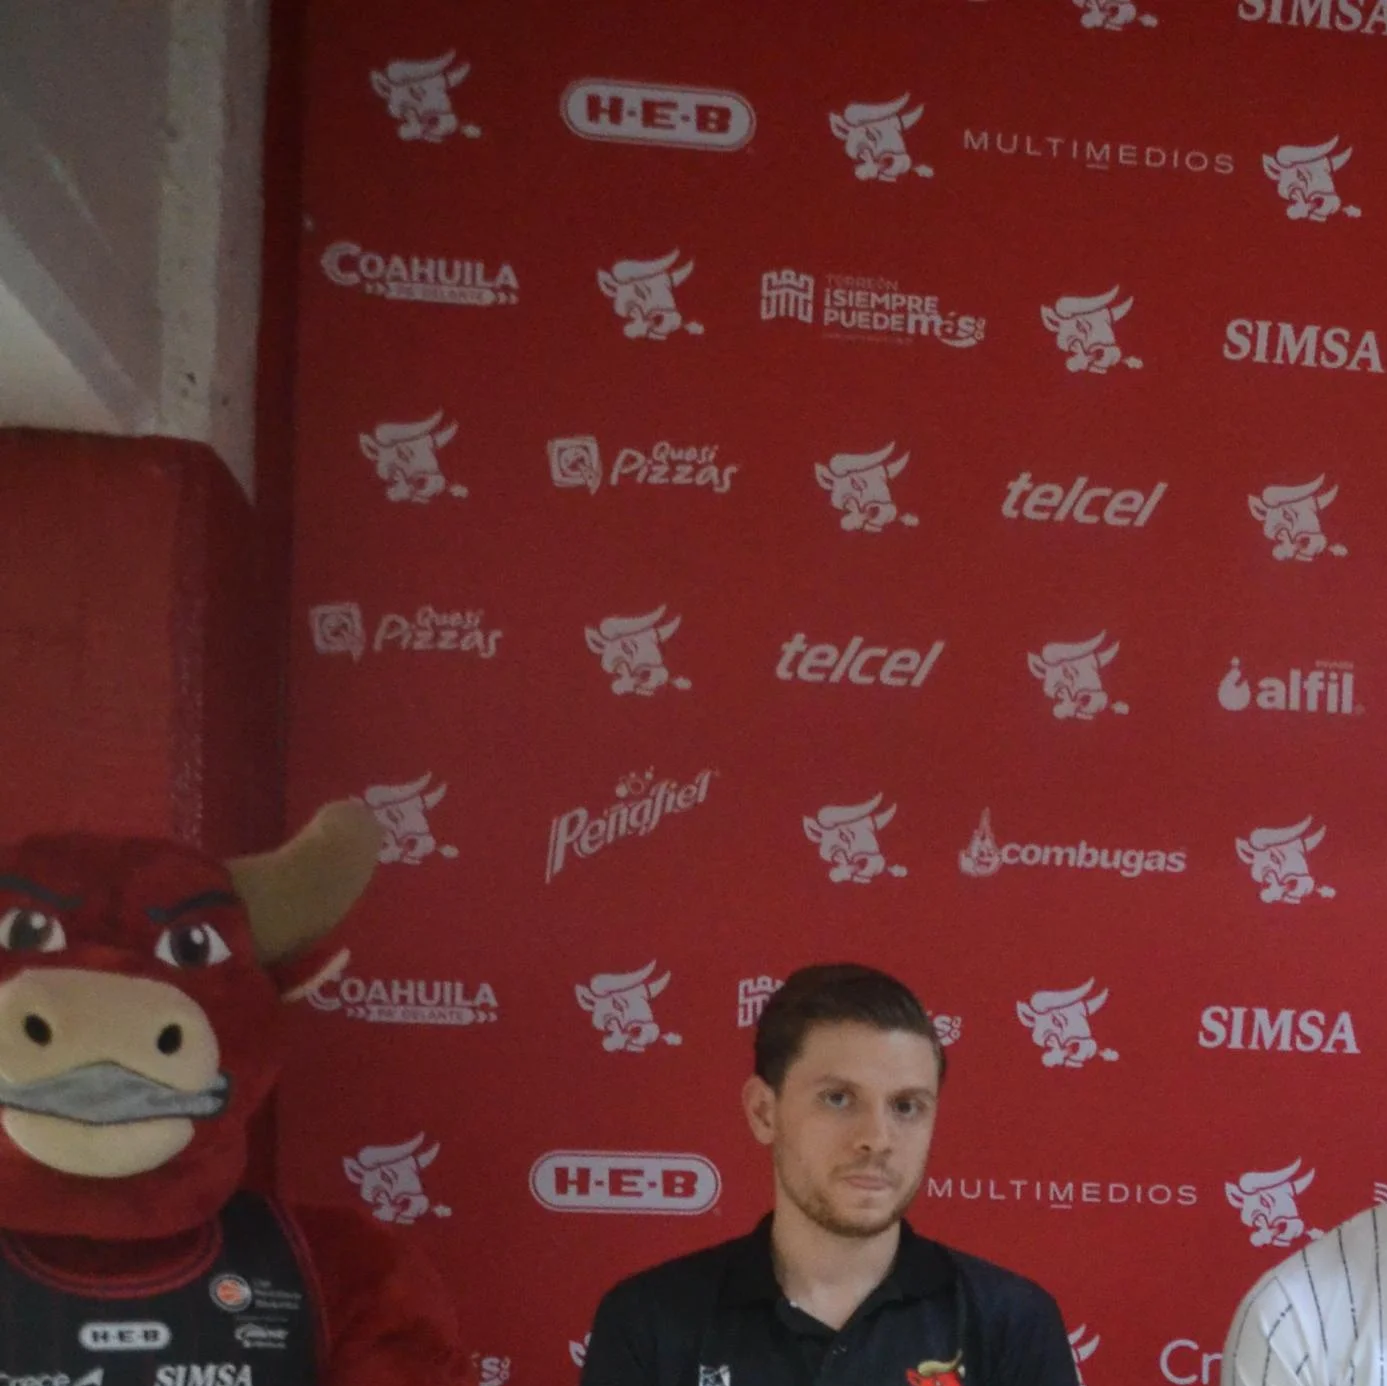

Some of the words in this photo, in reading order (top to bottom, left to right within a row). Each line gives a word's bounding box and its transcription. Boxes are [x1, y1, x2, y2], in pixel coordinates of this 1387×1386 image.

[963, 128, 1236, 174] MULTIMEDIOS
[321, 240, 519, 291] COAHUILA
[1222, 318, 1387, 374] SIMSA
[610, 447, 738, 494] Pizzas
[1000, 471, 1169, 528] telcel
[374, 613, 503, 659] Pizzas
[775, 633, 946, 687] telcel
[1256, 667, 1356, 714] alfil
[1001, 840, 1188, 877] combugas
[1198, 1005, 1361, 1055] SIMSA
[927, 1176, 1198, 1209] MULTIMEDIOS
